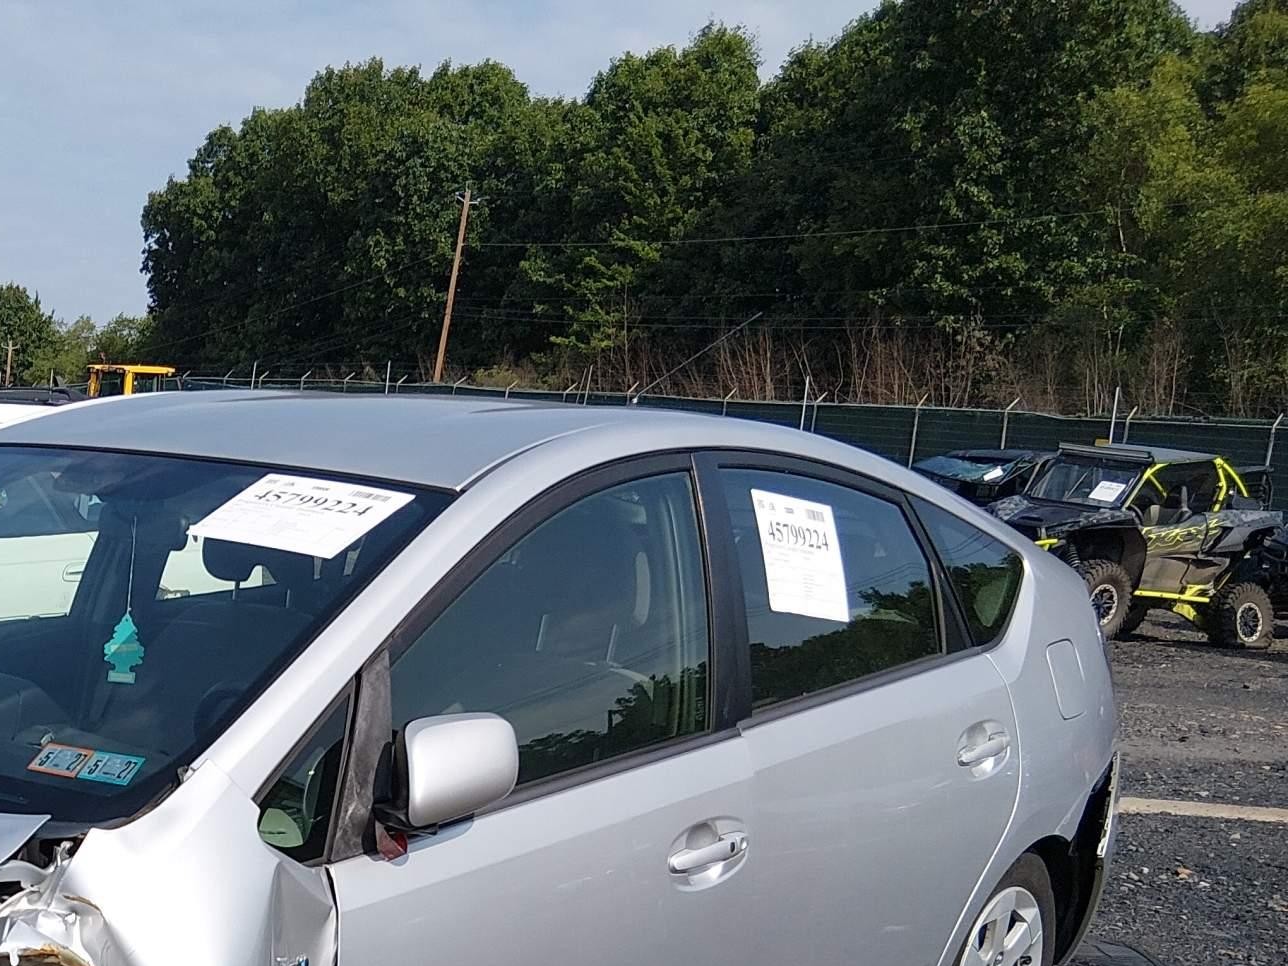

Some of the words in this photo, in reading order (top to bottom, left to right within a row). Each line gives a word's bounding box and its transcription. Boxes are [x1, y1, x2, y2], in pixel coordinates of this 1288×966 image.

[253, 487, 374, 517] 45799224
[768, 520, 829, 551] 45799224
[65, 752, 88, 771] 27
[116, 760, 138, 779] 27
